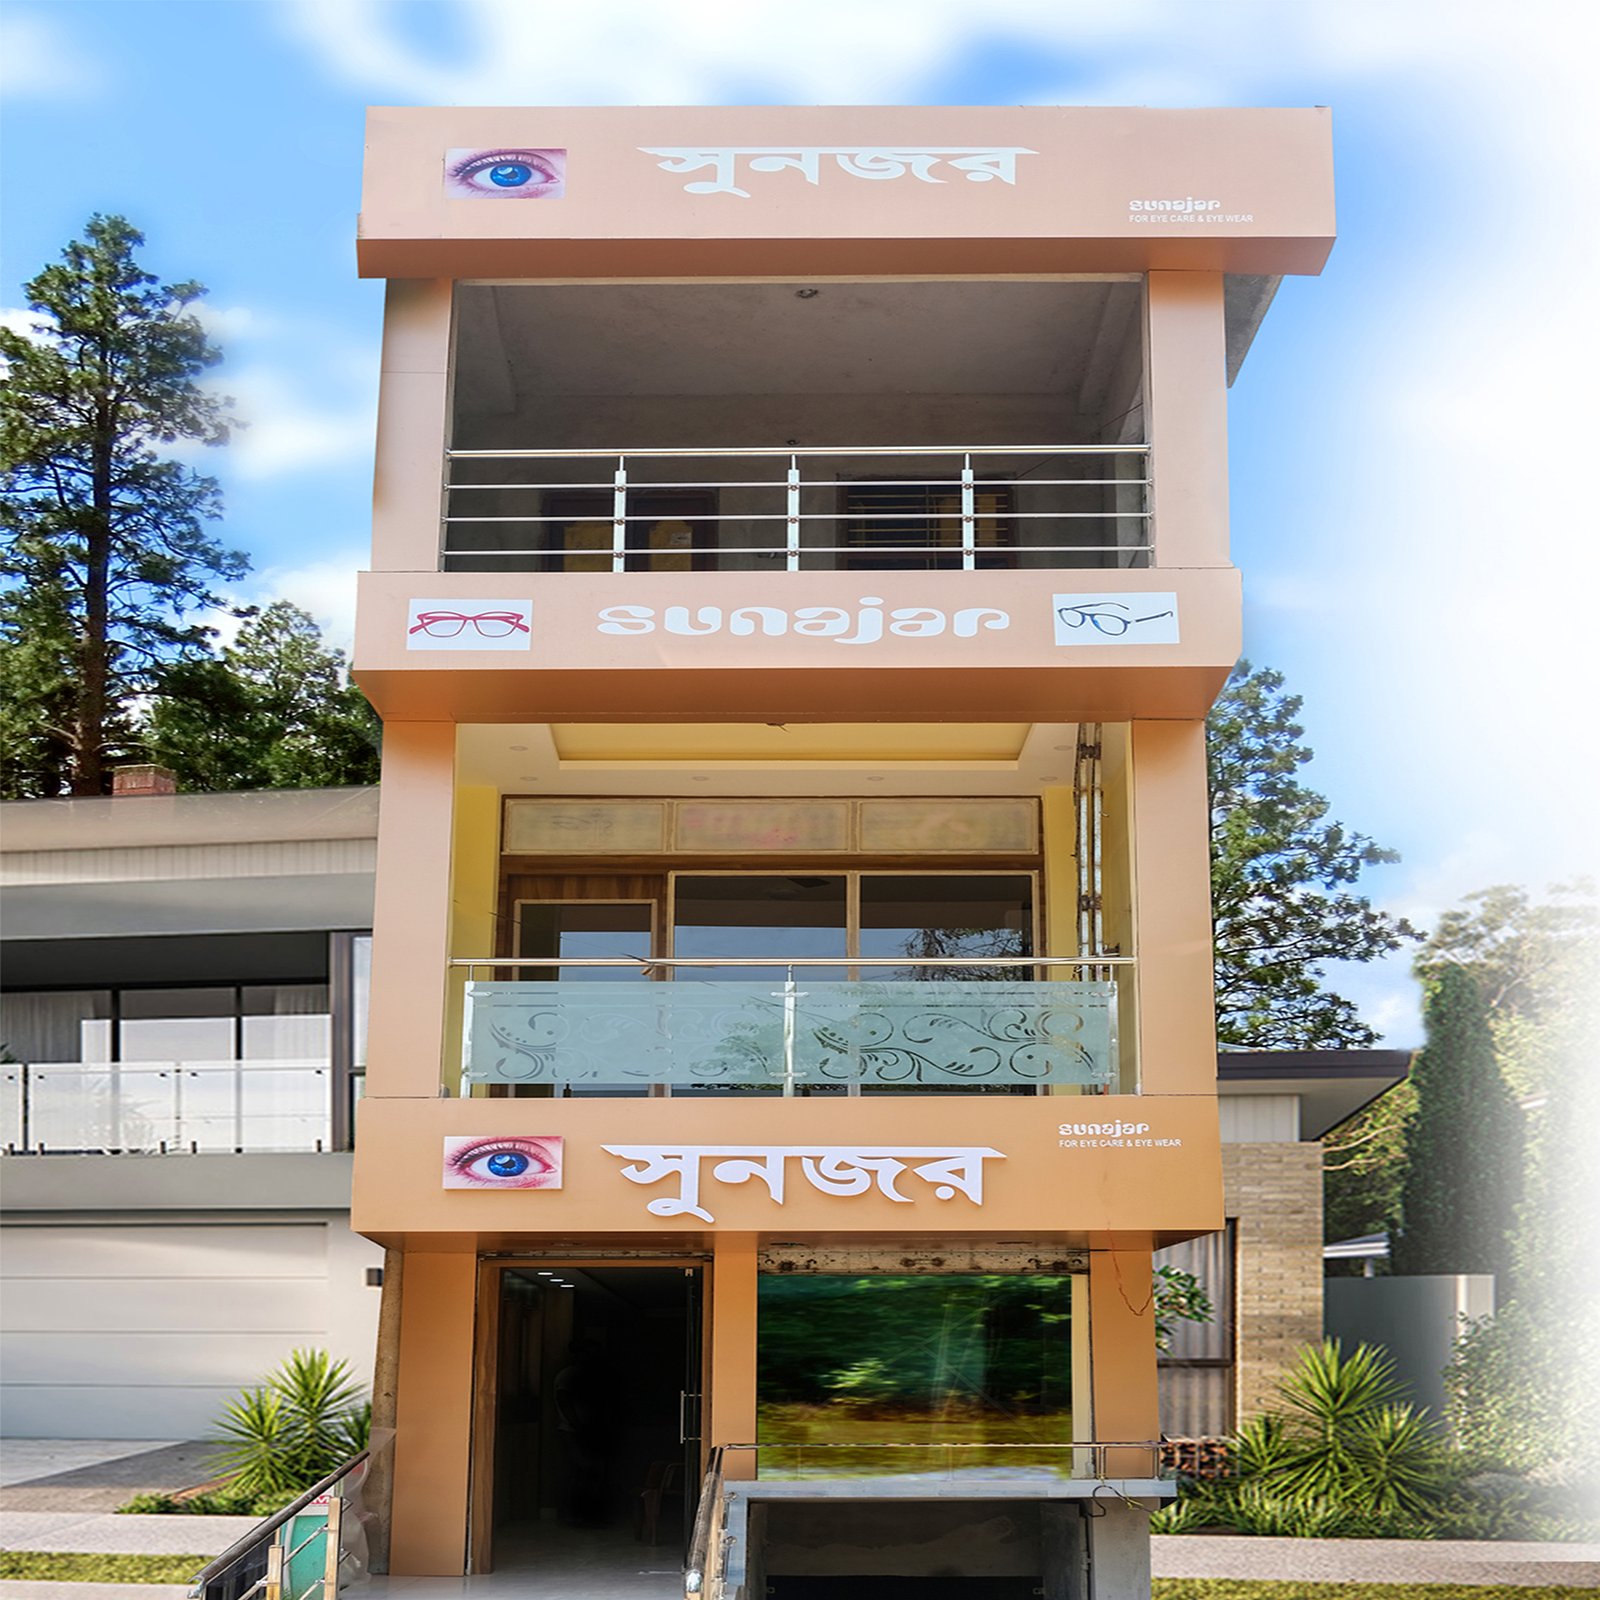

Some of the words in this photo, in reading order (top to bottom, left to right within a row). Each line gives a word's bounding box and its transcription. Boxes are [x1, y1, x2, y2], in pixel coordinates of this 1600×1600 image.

[636, 146, 1040, 198] সুনজর
[1129, 196, 1221, 214] sunajar
[1129, 214, 1149, 223] FOR
[1150, 214, 1168, 223] EYE
[1169, 214, 1195, 223] CARE
[1197, 214, 1205, 223] &
[1206, 214, 1224, 223] EYE
[1225, 214, 1254, 223] WEAR
[596, 596, 1010, 645] sunajar
[1058, 1119, 1150, 1138] sunajar
[1058, 1138, 1078, 1148] FOR
[1079, 1138, 1098, 1148] EYE
[1099, 1138, 1124, 1148] CARE
[1126, 1138, 1133, 1148] &
[1134, 1138, 1153, 1148] EYE
[1154, 1138, 1182, 1148] WEAR
[600, 1144, 1008, 1224] সুনজর
